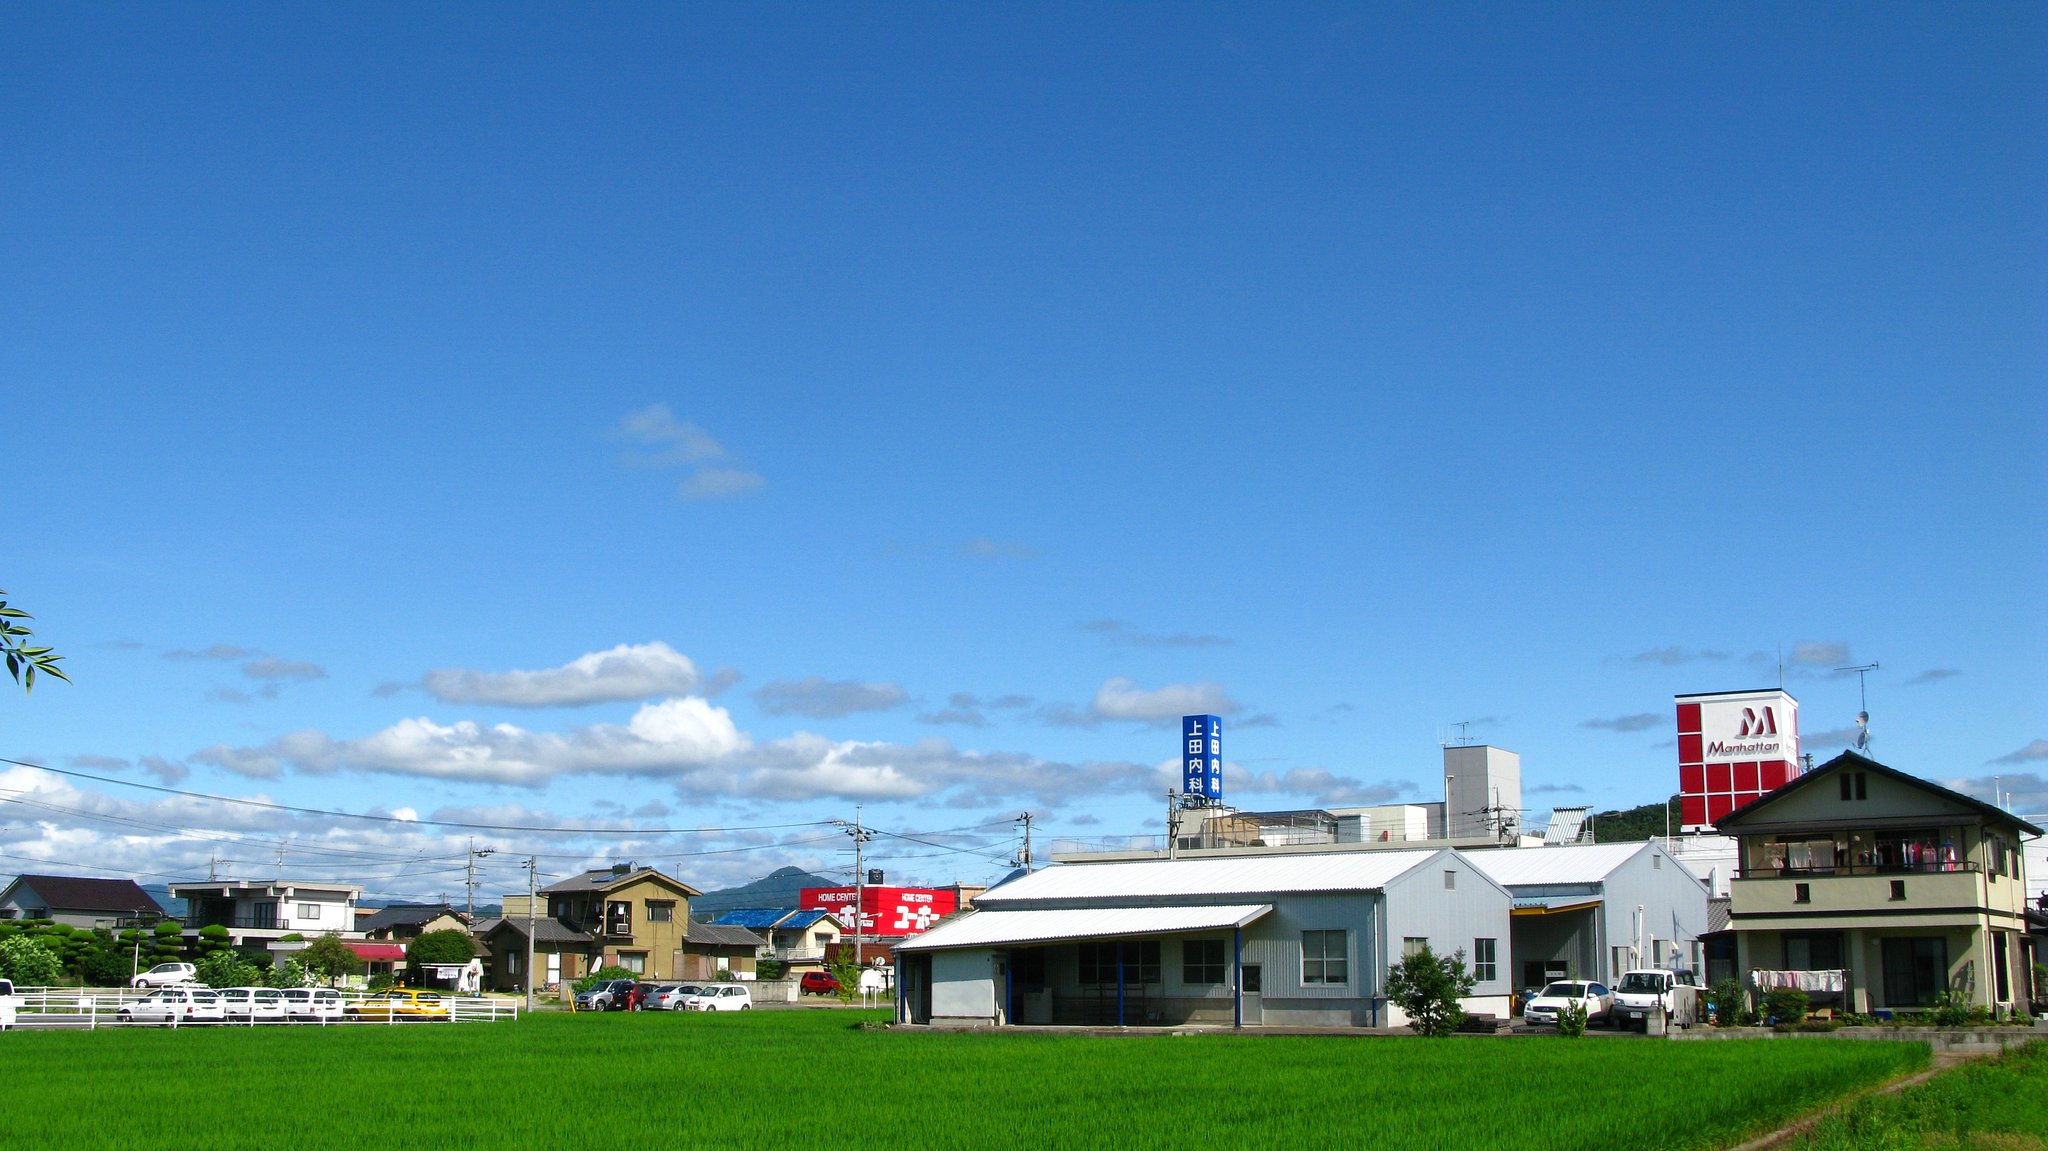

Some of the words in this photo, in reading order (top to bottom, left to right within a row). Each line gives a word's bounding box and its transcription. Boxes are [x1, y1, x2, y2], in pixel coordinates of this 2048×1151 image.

[1188, 720, 1203, 793] 上田内科
[1210, 721, 1220, 793] 上田内科
[1708, 741, 1780, 755] Manhattan
[818, 892, 835, 902] HOME
[836, 892, 858, 902] CENTE
[902, 893, 915, 902] HOME
[915, 894, 933, 902] CENTER
[894, 905, 940, 929] ユーホー
